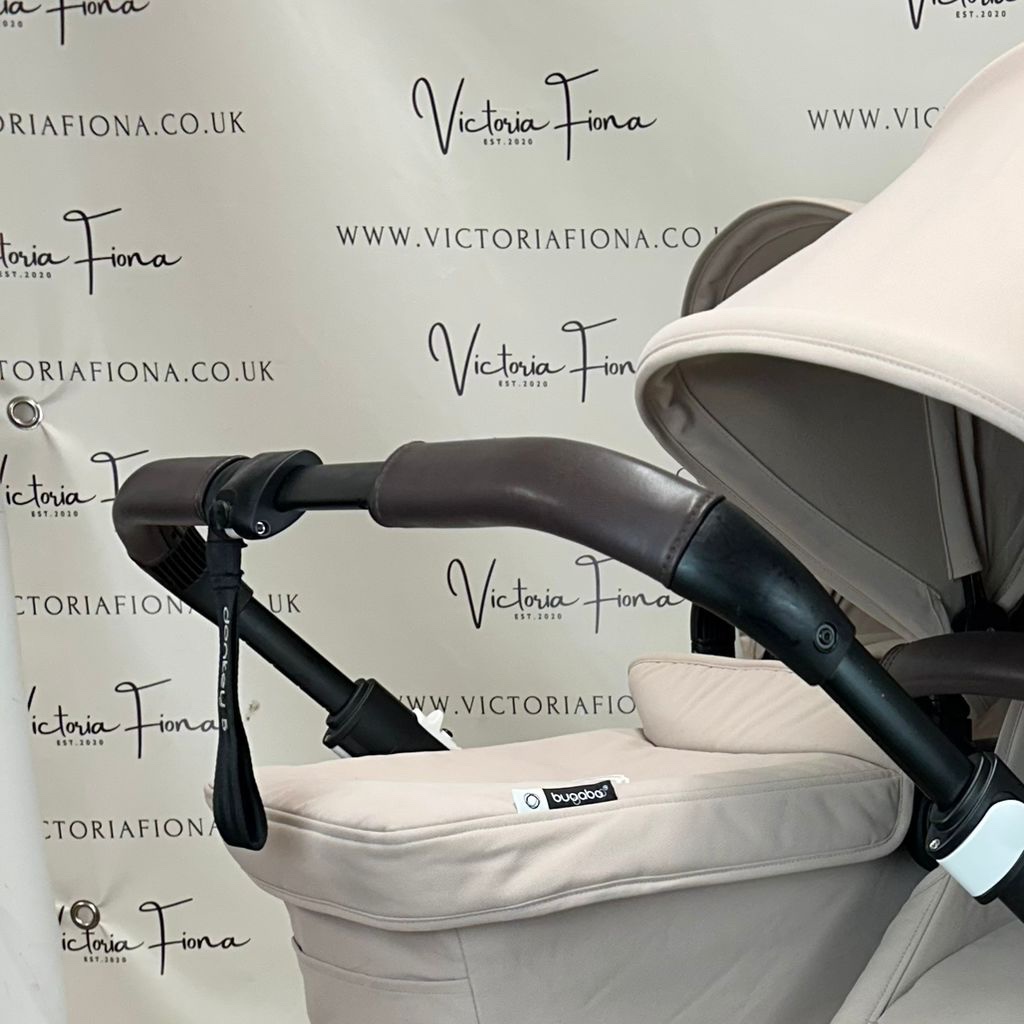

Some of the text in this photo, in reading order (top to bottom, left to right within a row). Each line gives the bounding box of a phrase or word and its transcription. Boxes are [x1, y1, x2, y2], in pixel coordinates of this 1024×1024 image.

[0, 112, 246, 137] RIAFIONA.CO.UK
[412, 69, 657, 161] Victoria Fiona
[0, 208, 182, 295] toria Fiona
[336, 225, 720, 249] WWW.VICTORIAFIONA.CO
[0, 360, 274, 382] TORIAFIONA.CO.UK
[428, 318, 635, 402] Victoria Fion
[447, 554, 689, 633] Victoria Fiona
[28, 679, 219, 758] ictoria Fiona
[58, 898, 251, 975] ictoria Fiona
